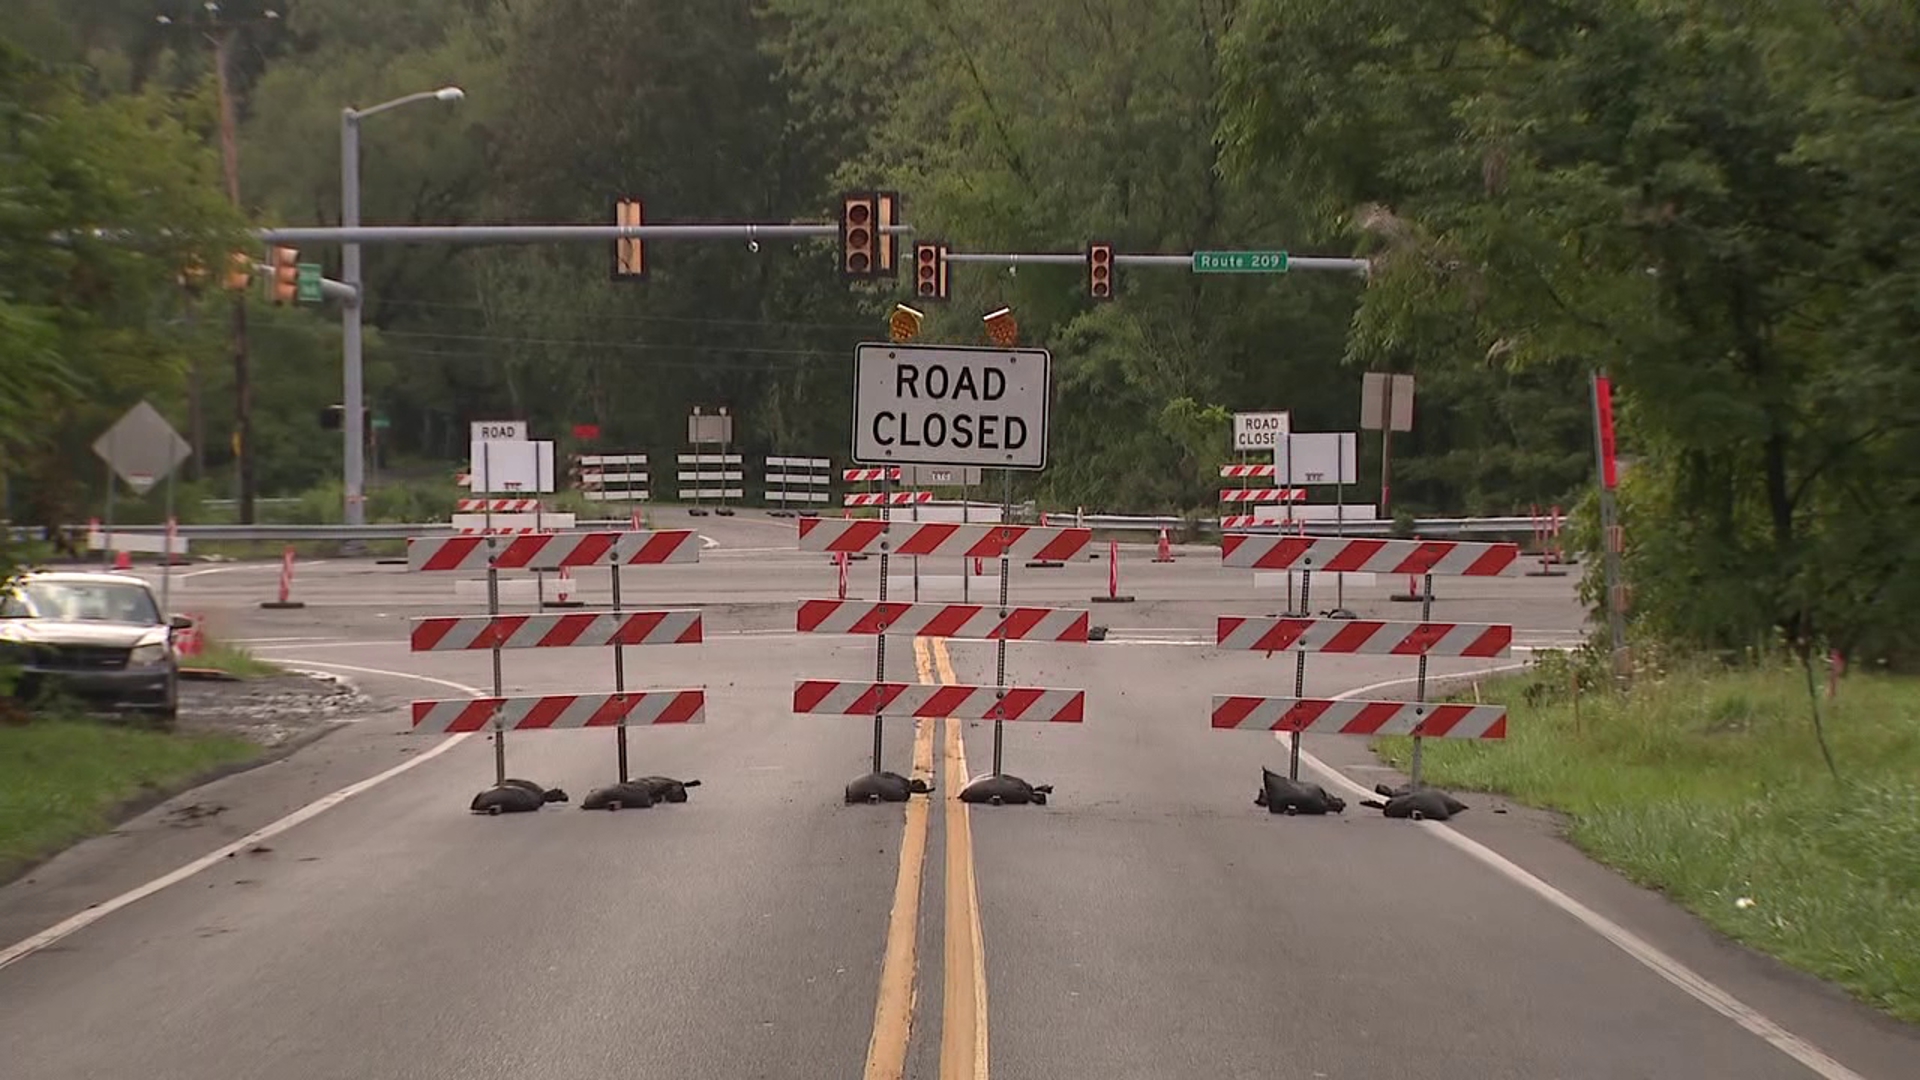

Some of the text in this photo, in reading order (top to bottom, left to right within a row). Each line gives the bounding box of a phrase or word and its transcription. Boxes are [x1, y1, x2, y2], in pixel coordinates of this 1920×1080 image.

[1201, 255, 1279, 268] Route 209
[896, 364, 1006, 401] ROAD
[1245, 417, 1279, 430] ROAD
[482, 426, 515, 439] ROAD
[872, 411, 1027, 450] CLOSED
[1238, 432, 1275, 445] CLOSE
